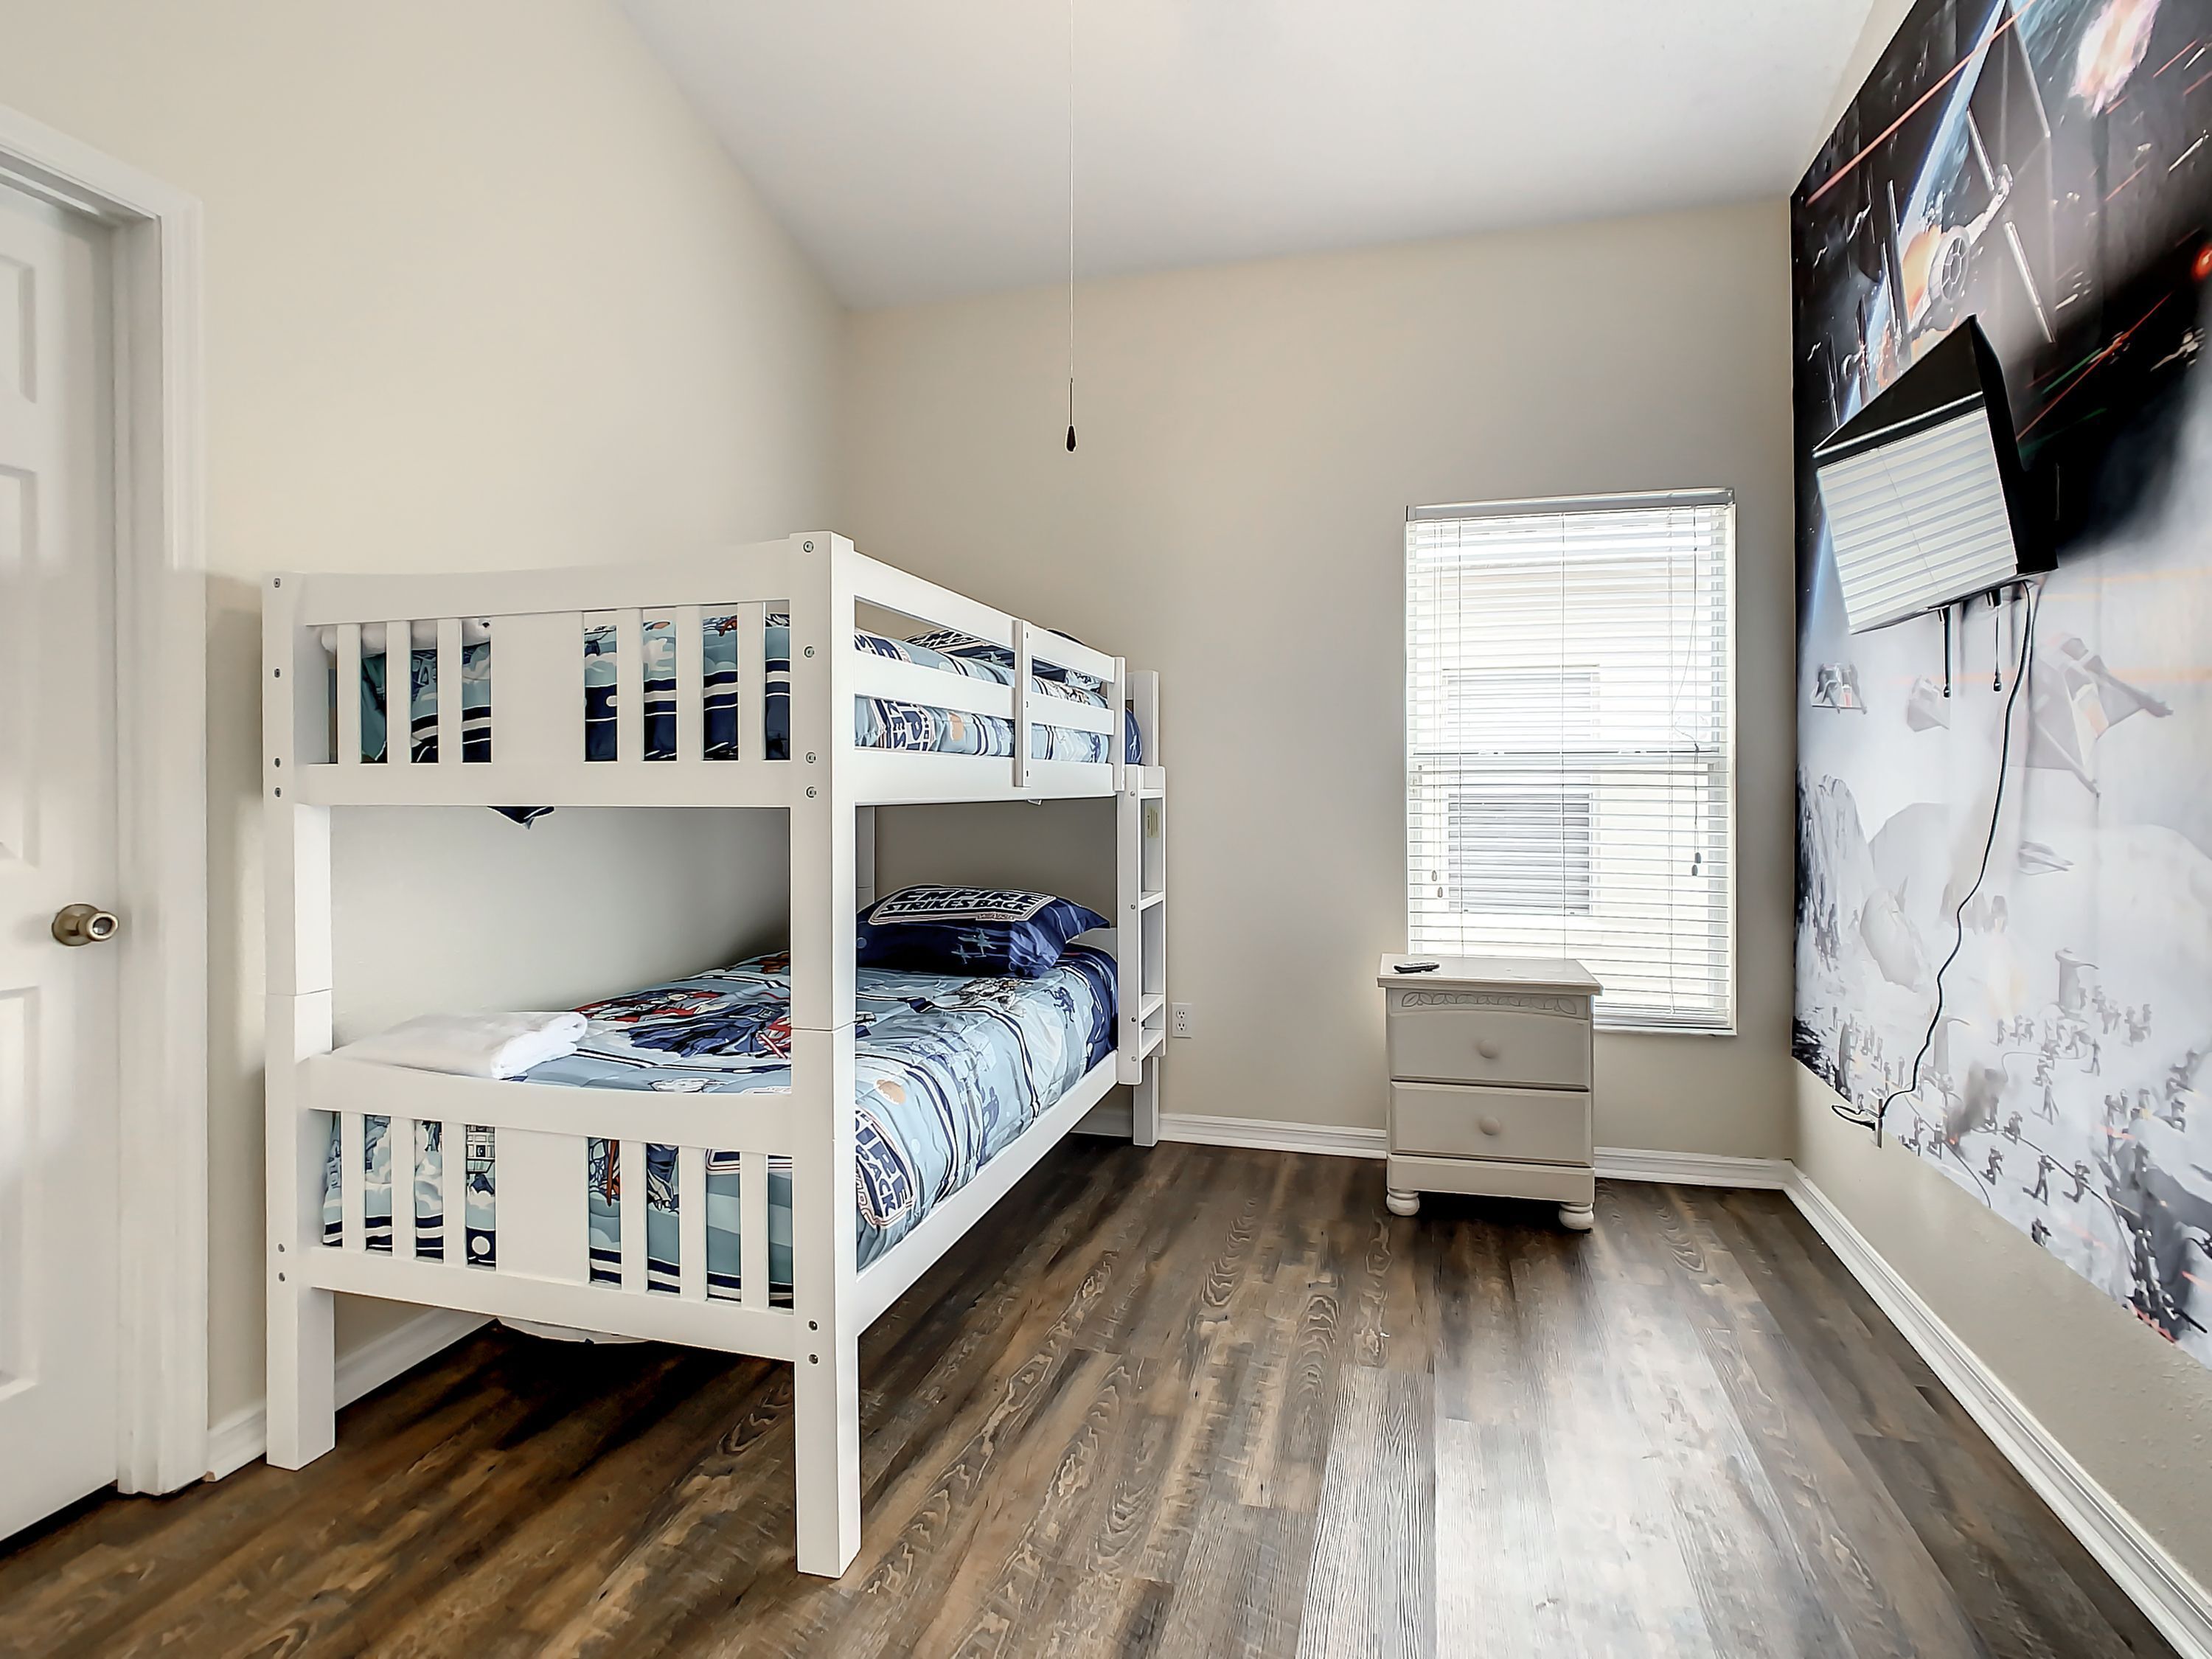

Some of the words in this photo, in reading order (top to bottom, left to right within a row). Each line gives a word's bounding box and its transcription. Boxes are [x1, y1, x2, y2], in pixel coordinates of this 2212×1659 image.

[890, 889, 1047, 904] EMPIRE
[885, 899, 972, 912] STRIKES
[973, 899, 1032, 912] BACK
